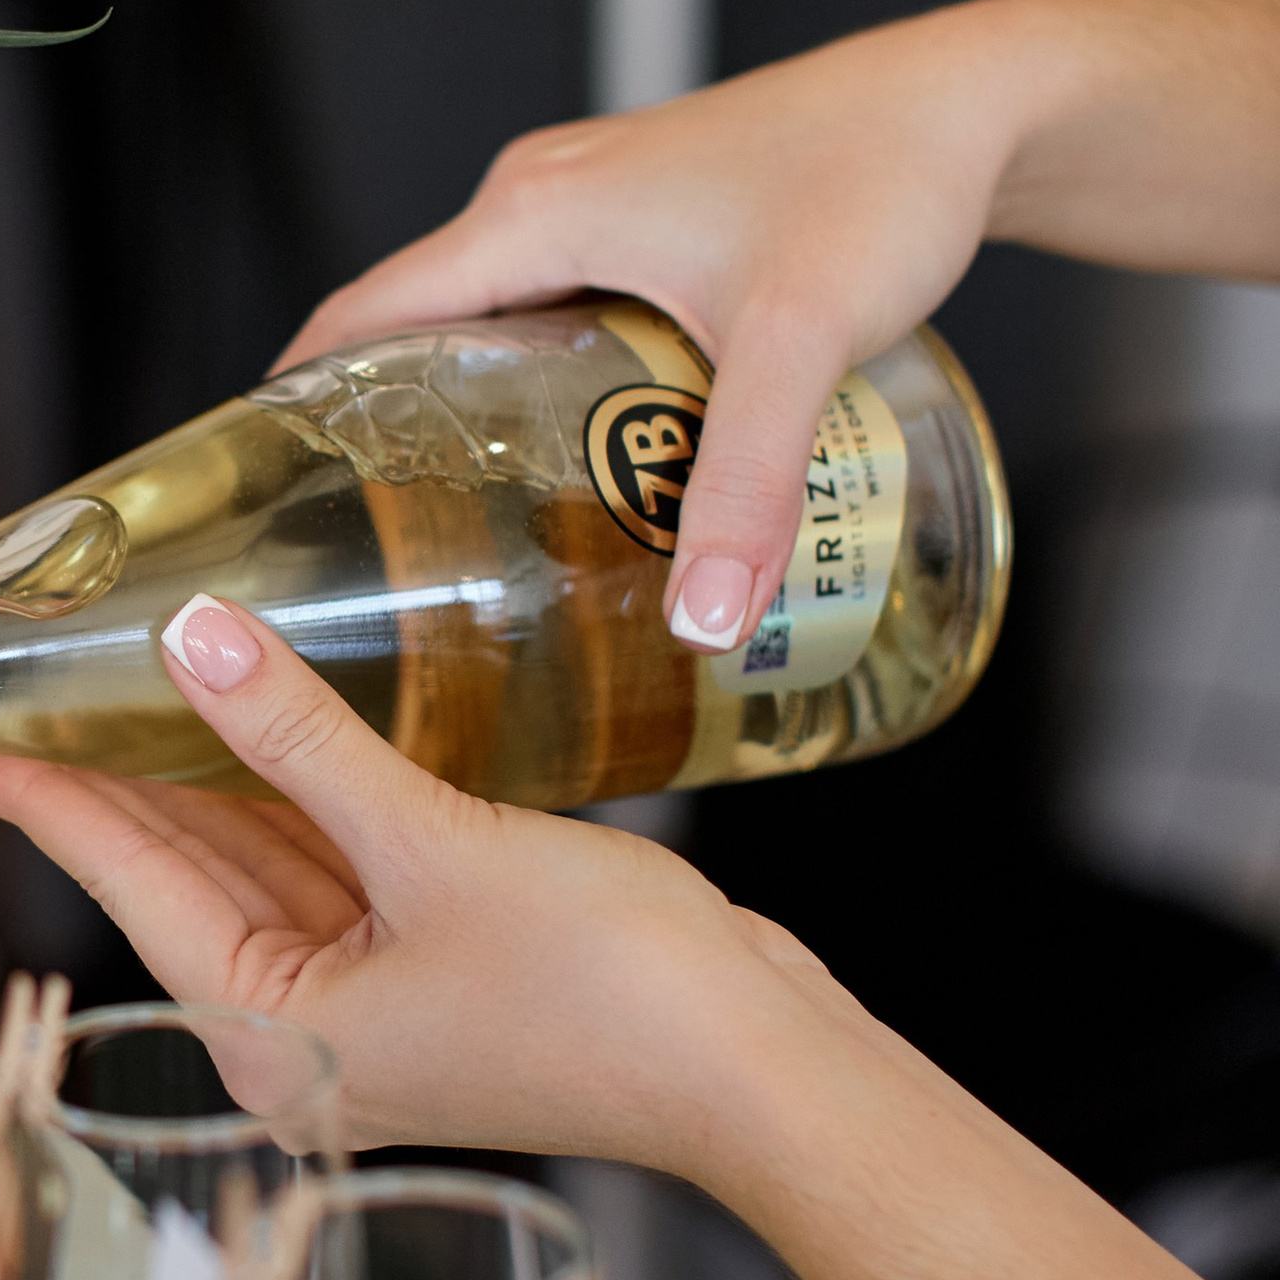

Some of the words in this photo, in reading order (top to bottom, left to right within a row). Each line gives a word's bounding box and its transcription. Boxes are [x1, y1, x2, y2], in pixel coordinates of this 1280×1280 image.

[806, 428, 844, 600] FRIZZ
[853, 433, 880, 498] WHITE
[847, 501, 867, 601] LIGHTLY
